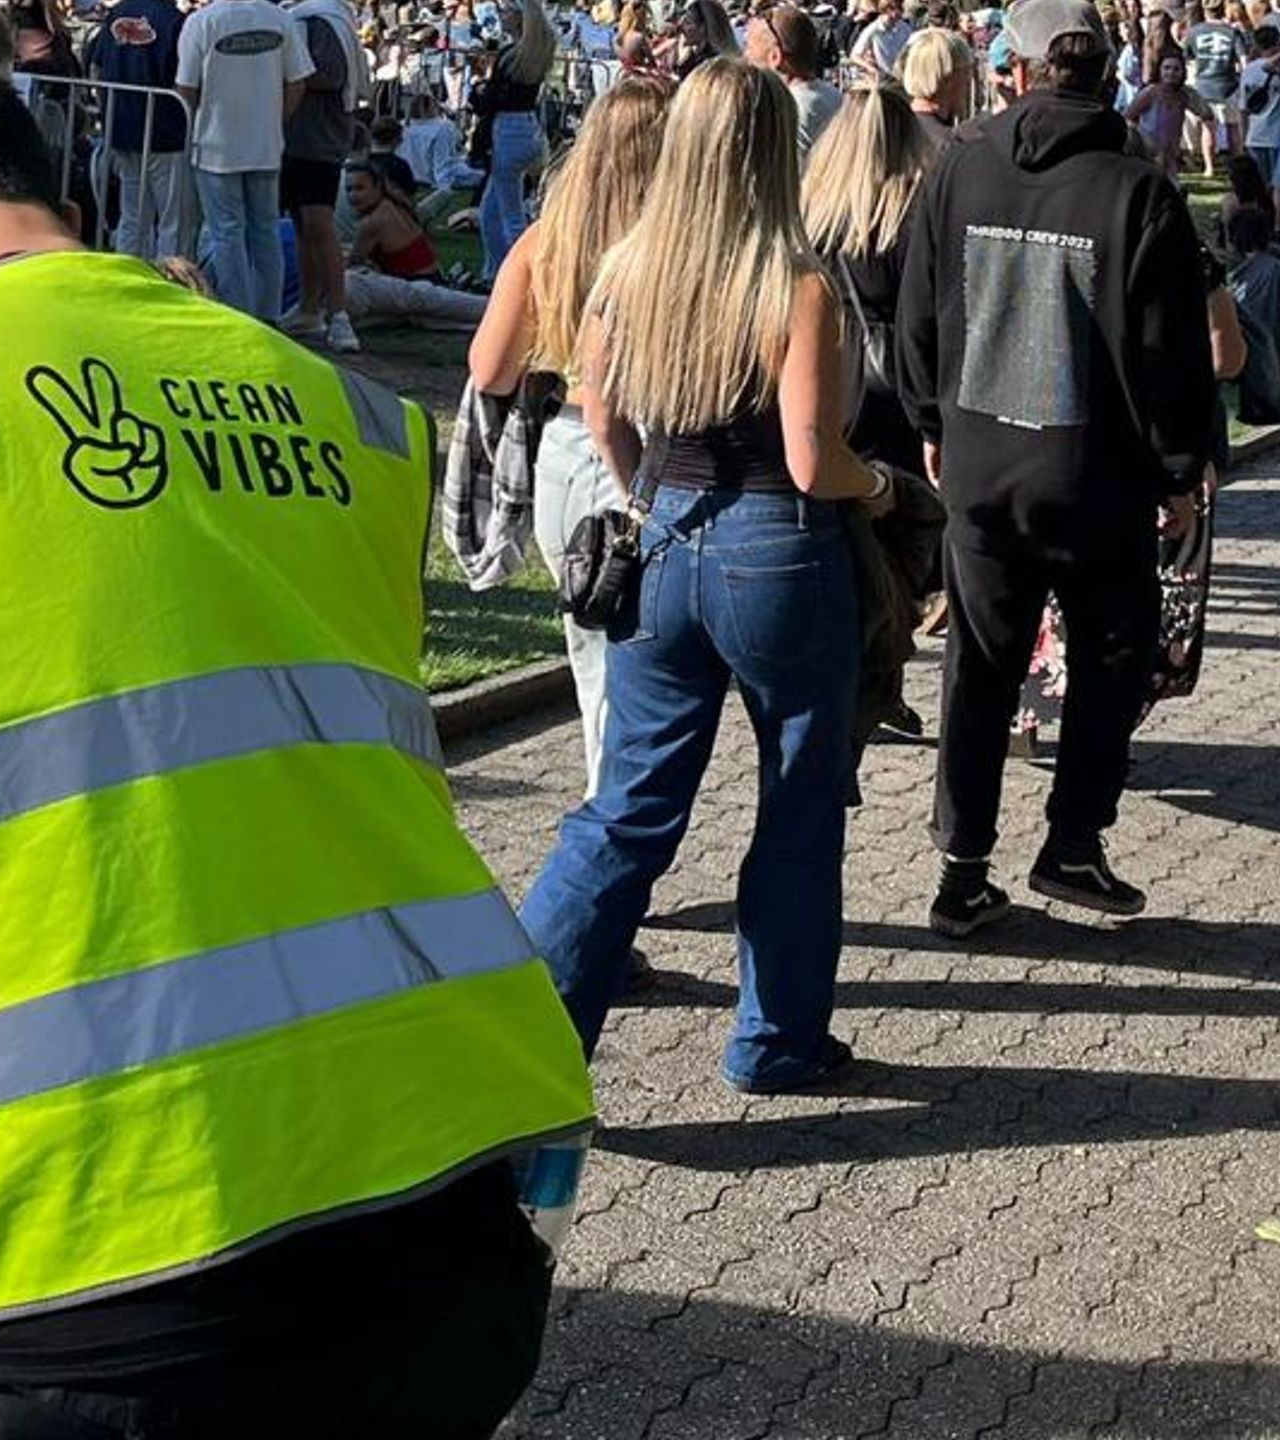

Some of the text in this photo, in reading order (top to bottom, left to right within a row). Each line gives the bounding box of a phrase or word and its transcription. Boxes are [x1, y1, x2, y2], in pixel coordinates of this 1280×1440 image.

[1025, 230, 1059, 244] CREW
[1059, 235, 1093, 250] 2023
[160, 377, 303, 426] CLEAN
[180, 429, 352, 507] VIBES
